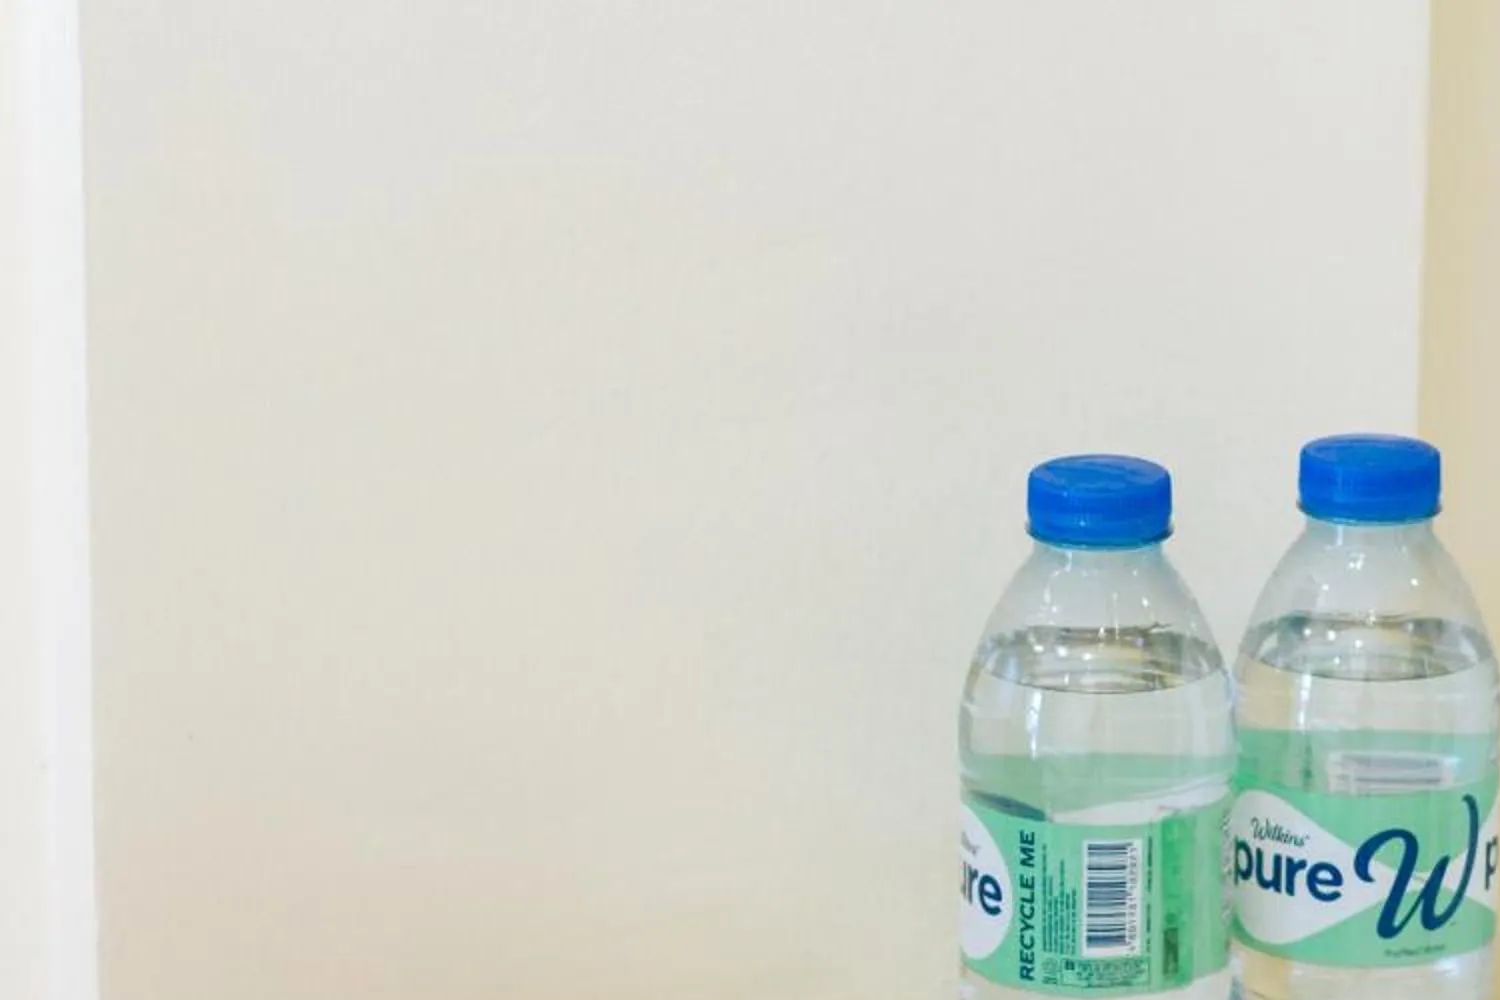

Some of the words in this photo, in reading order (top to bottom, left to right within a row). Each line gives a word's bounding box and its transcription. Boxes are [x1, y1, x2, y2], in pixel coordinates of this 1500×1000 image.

[1018, 830, 1036, 869] ME
[1234, 836, 1344, 902] pure
[1018, 876, 1036, 981] RECYCLE
